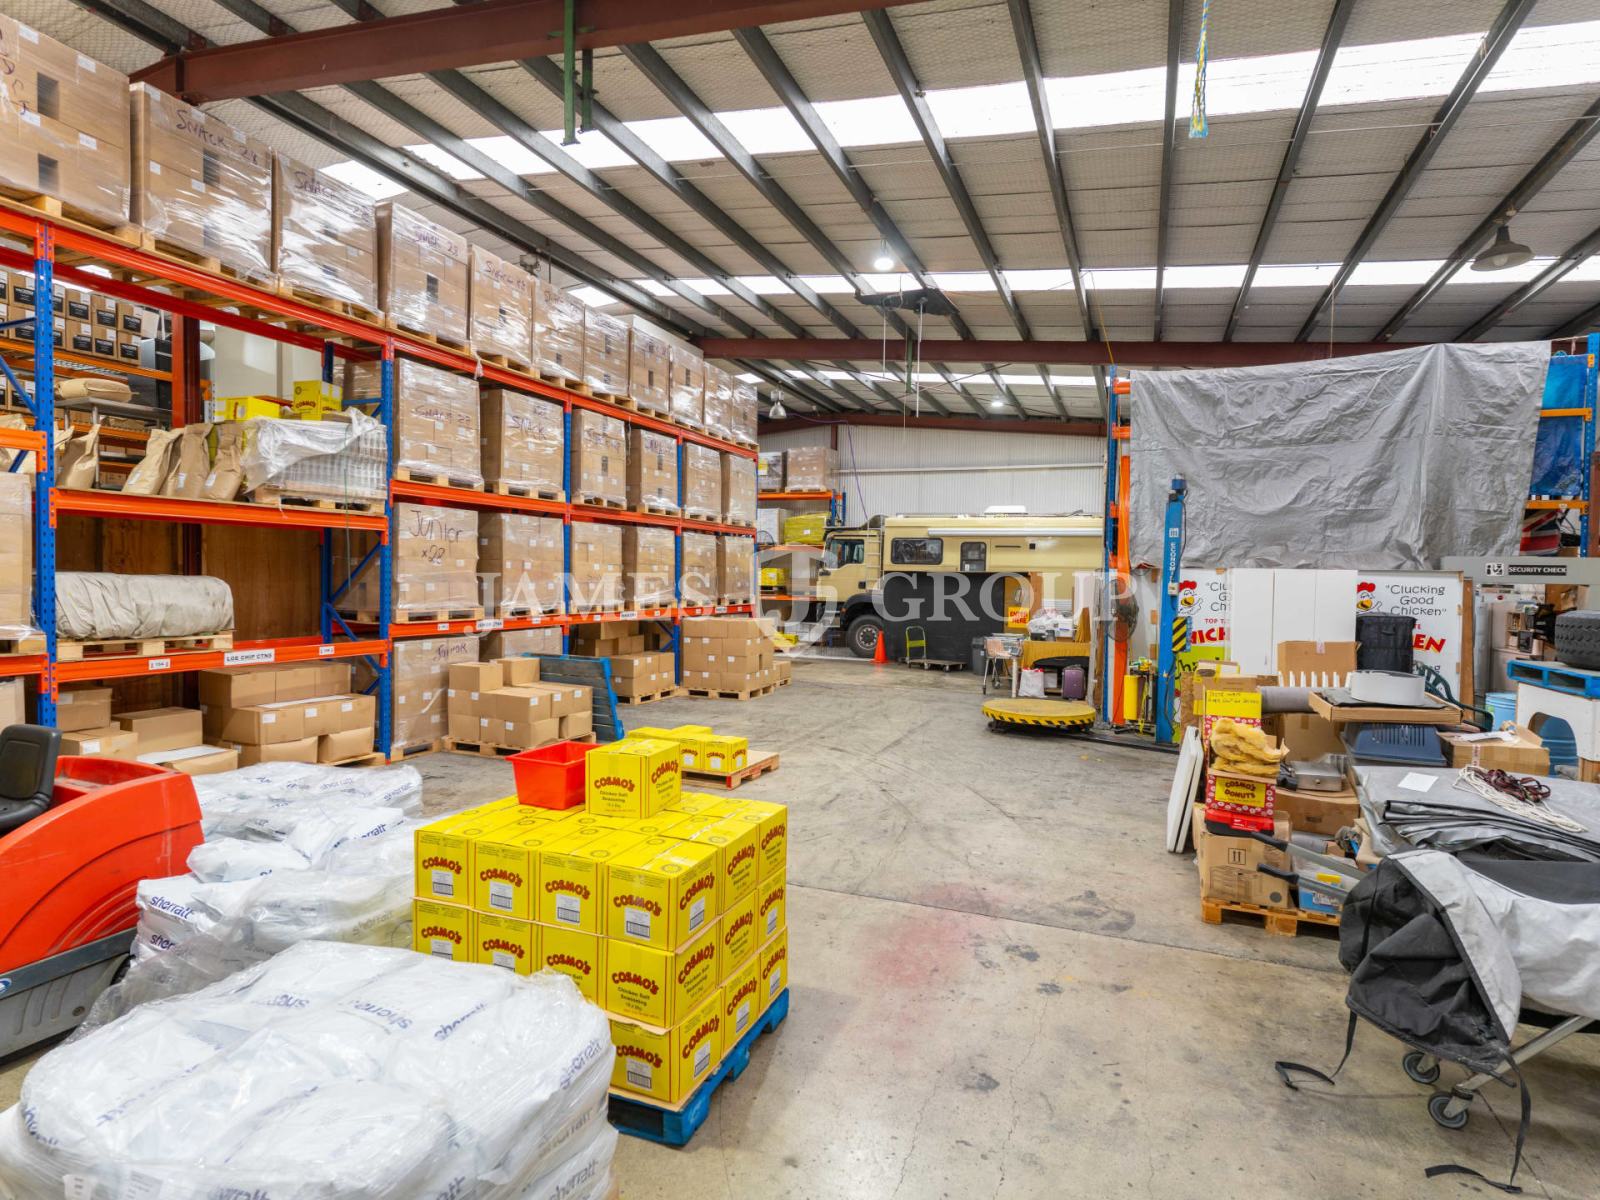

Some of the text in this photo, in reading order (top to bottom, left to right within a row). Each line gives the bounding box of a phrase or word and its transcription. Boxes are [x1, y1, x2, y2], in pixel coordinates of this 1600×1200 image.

[1400, 596, 1434, 605] Good
[594, 777, 635, 792] COSMO'S
[1224, 789, 1256, 799] DONUTS
[422, 857, 462, 875] COSMO'S
[480, 869, 523, 887] COSMO'S
[545, 880, 590, 900] COSMO'S
[680, 872, 715, 910] COSMO'S
[151, 895, 194, 919] sherratt
[421, 926, 462, 944] COSMO'S
[483, 939, 525, 959] COSMO'S
[678, 942, 715, 984] COSMO'S
[612, 972, 659, 995] COSMO'S
[682, 1014, 719, 1059] COSMO'S
